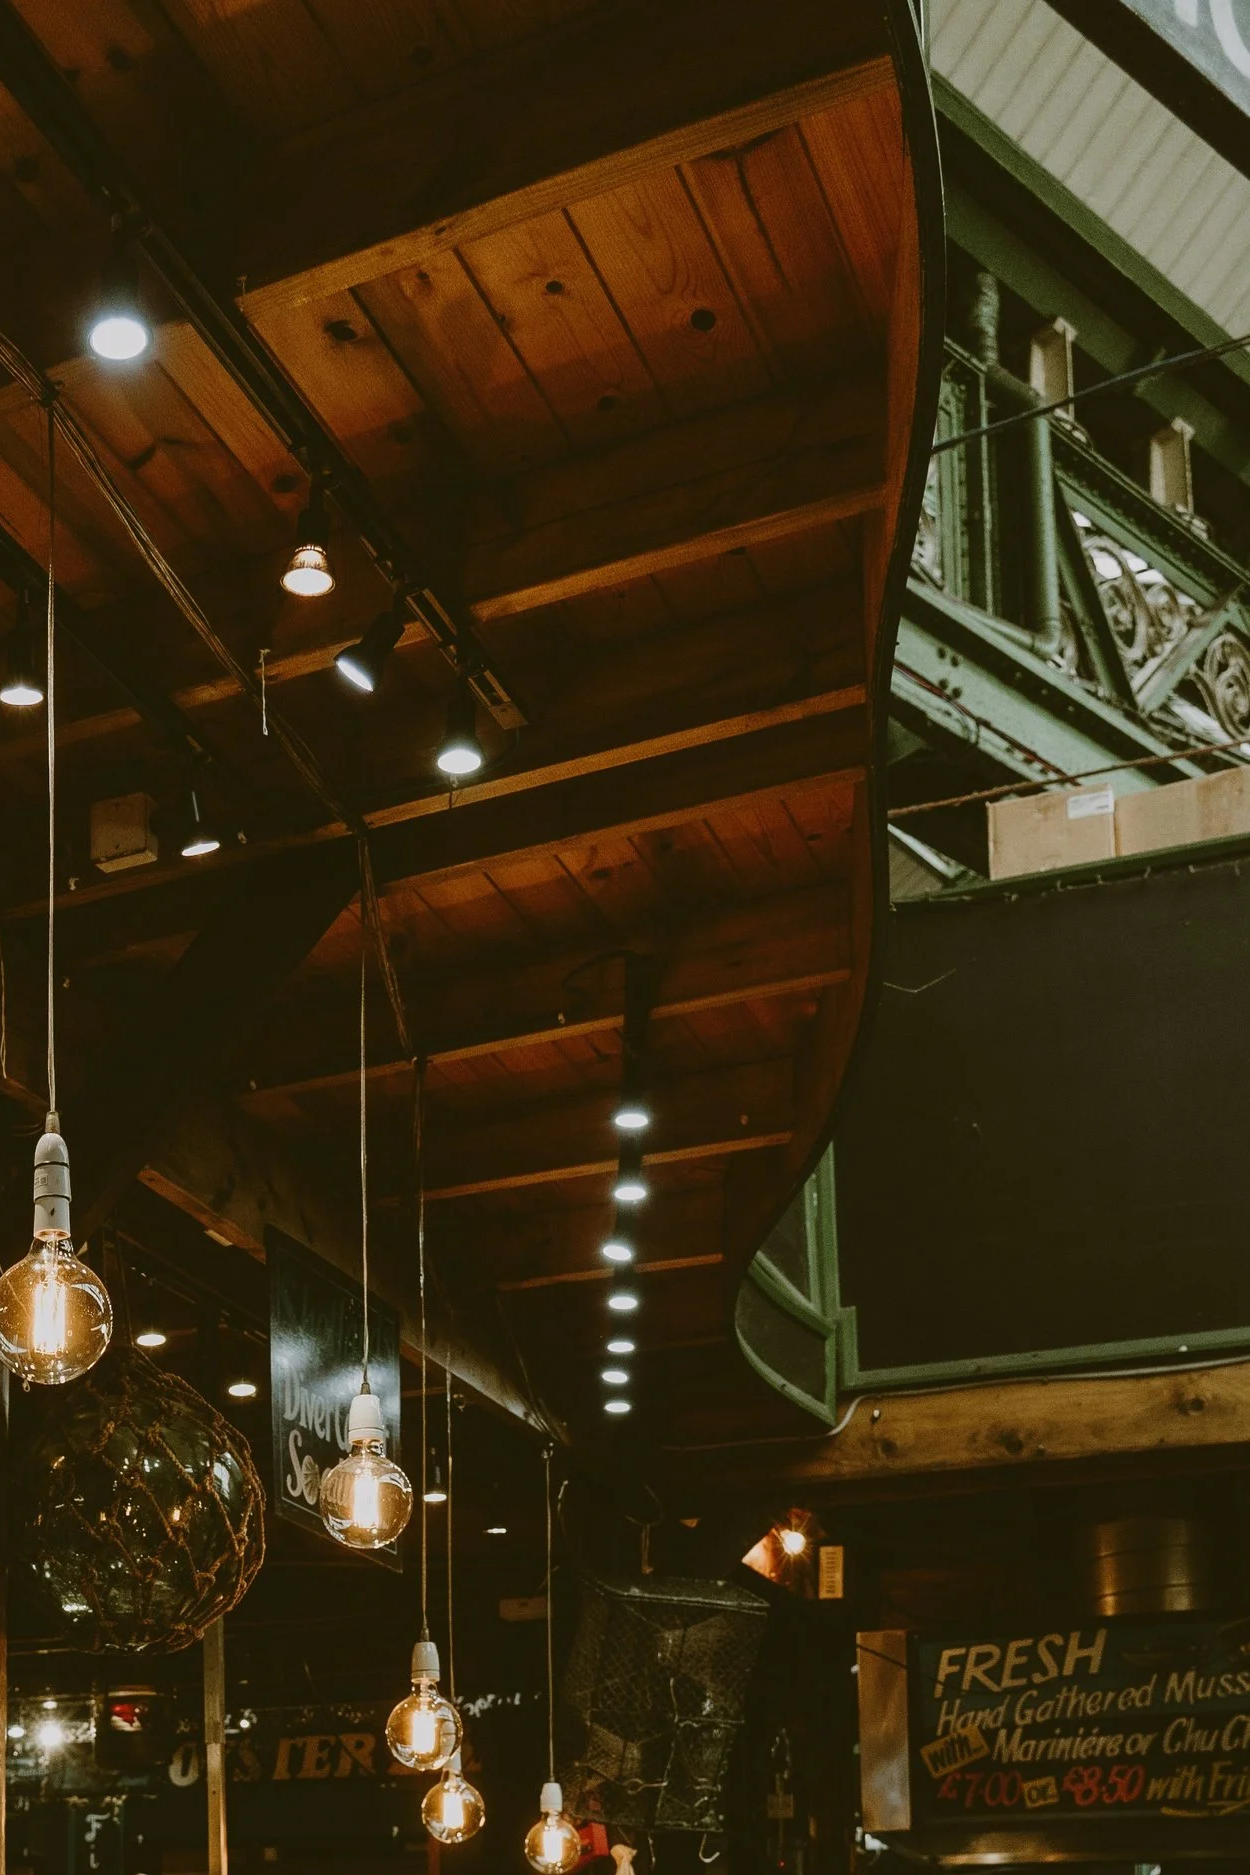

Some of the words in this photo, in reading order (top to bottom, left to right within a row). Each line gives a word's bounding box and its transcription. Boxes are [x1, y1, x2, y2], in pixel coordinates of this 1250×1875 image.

[934, 1629, 1108, 1698] FRESH
[936, 1694, 1010, 1736] Hand
[1014, 1672, 1158, 1725] Gathered
[1146, 1764, 1206, 1801] with
